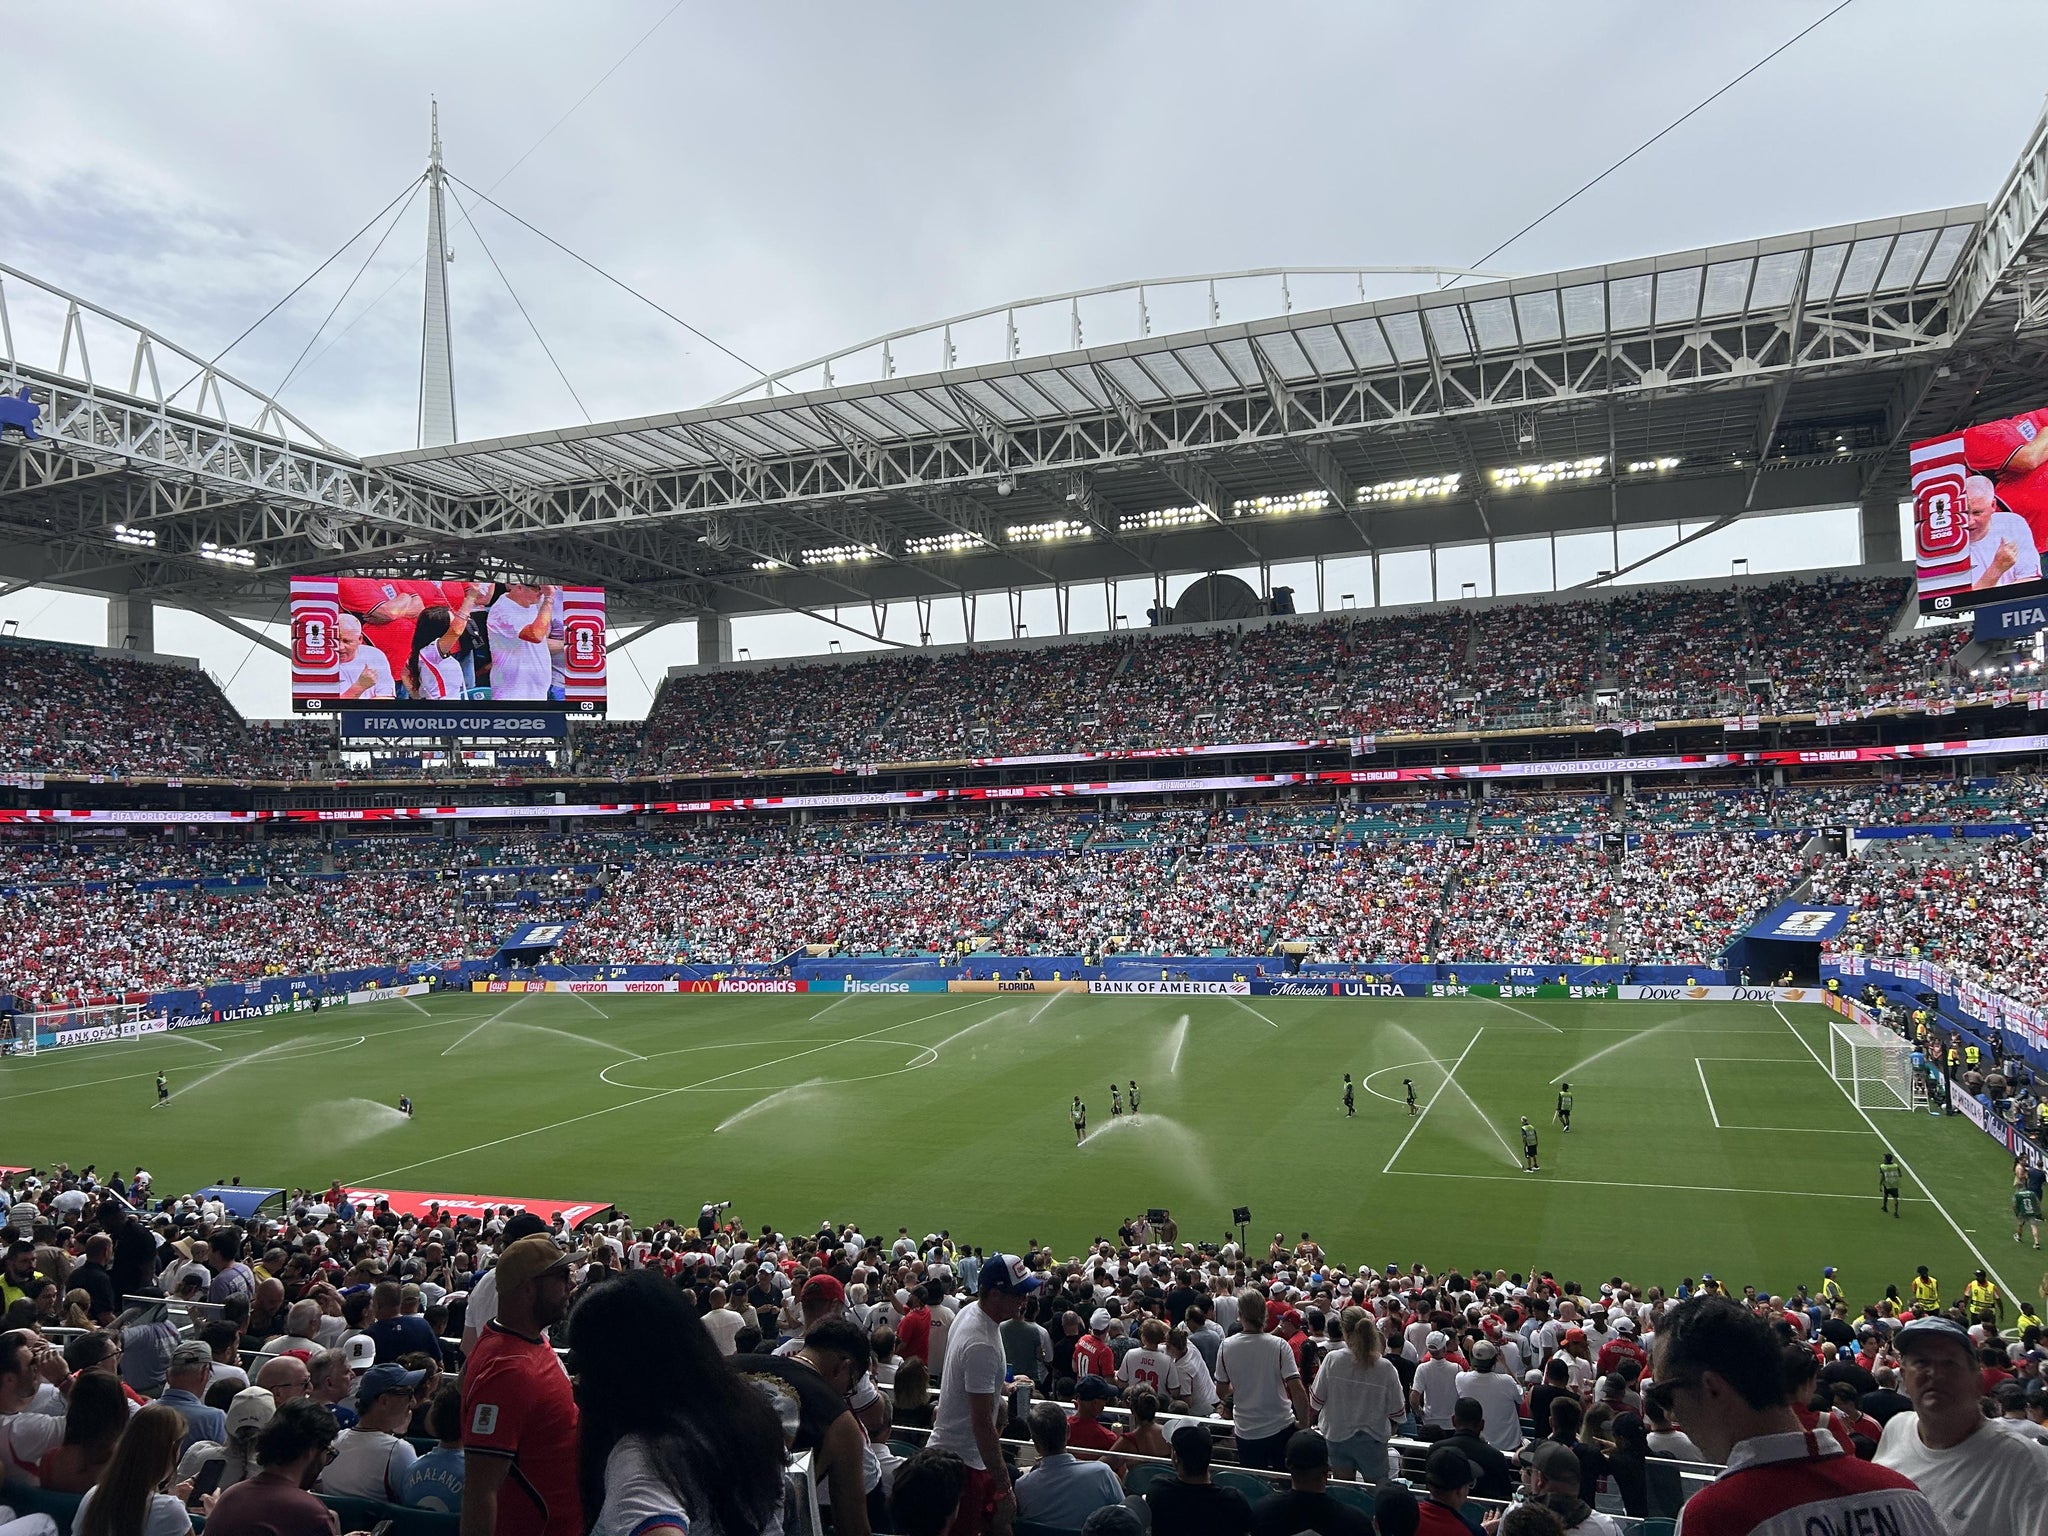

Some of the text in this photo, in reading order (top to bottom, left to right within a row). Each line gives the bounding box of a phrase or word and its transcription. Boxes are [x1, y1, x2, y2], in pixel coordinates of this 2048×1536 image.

[1936, 598, 1950, 608] CC
[2002, 607, 2046, 628] FIFA
[308, 700, 321, 708] CC
[582, 702, 593, 710] CC
[364, 718, 546, 730] FIFA WORLD CUP 2026
[1819, 750, 1857, 761] ENGLAND
[1524, 760, 1657, 774] FIFA WORLD CUP 2026
[1367, 771, 1397, 780] ENGLAND
[998, 788, 1023, 797] ENGLAND
[688, 802, 710, 810] ENGLAND
[111, 812, 214, 820] FIFA WORLD CUP 2026
[334, 811, 364, 819] ENGLAND
[1510, 967, 1535, 977] FIFA
[290, 981, 307, 990] FIFA
[569, 981, 607, 993] verizon
[625, 981, 665, 993] verizon
[718, 981, 796, 993] McDonald's
[844, 981, 909, 993] Hisense
[998, 982, 1035, 992] FLORIDA
[1095, 982, 1228, 993] BANK OF AMERICA
[1270, 983, 1404, 997] Michelob ULTRA
[369, 990, 394, 1002] Dove
[1639, 985, 1681, 1001] Dove
[1732, 986, 1775, 1001] Dove
[168, 1007, 263, 1031] Michelob ULTRA
[60, 1031, 89, 1043] BANK
[419, 1199, 526, 1211] ENGLAND
[1806, 1505, 1901, 1536] OWEN
